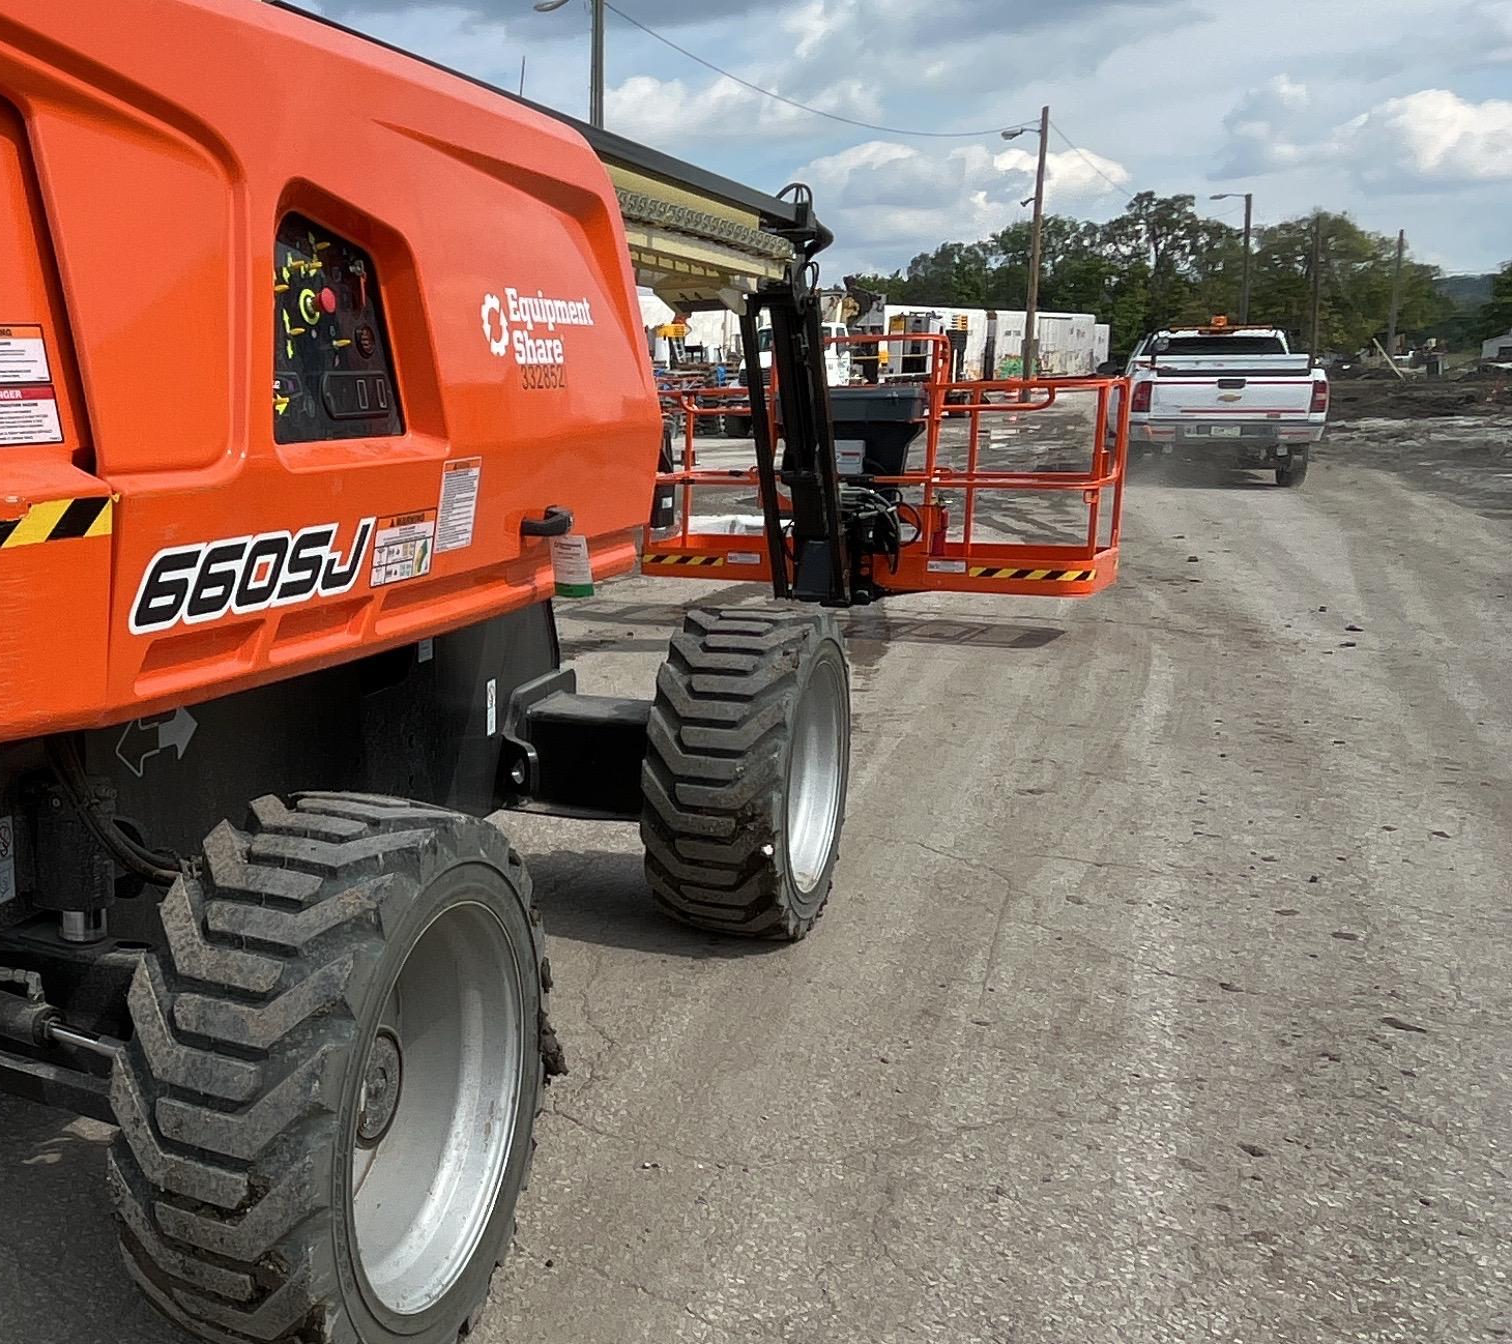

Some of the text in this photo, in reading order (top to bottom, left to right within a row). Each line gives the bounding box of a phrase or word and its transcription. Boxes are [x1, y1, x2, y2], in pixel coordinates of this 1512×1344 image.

[504, 287, 594, 331] Equipment
[513, 329, 565, 365] Share
[521, 365, 565, 389] 332852
[133, 520, 374, 630] 660SJ
